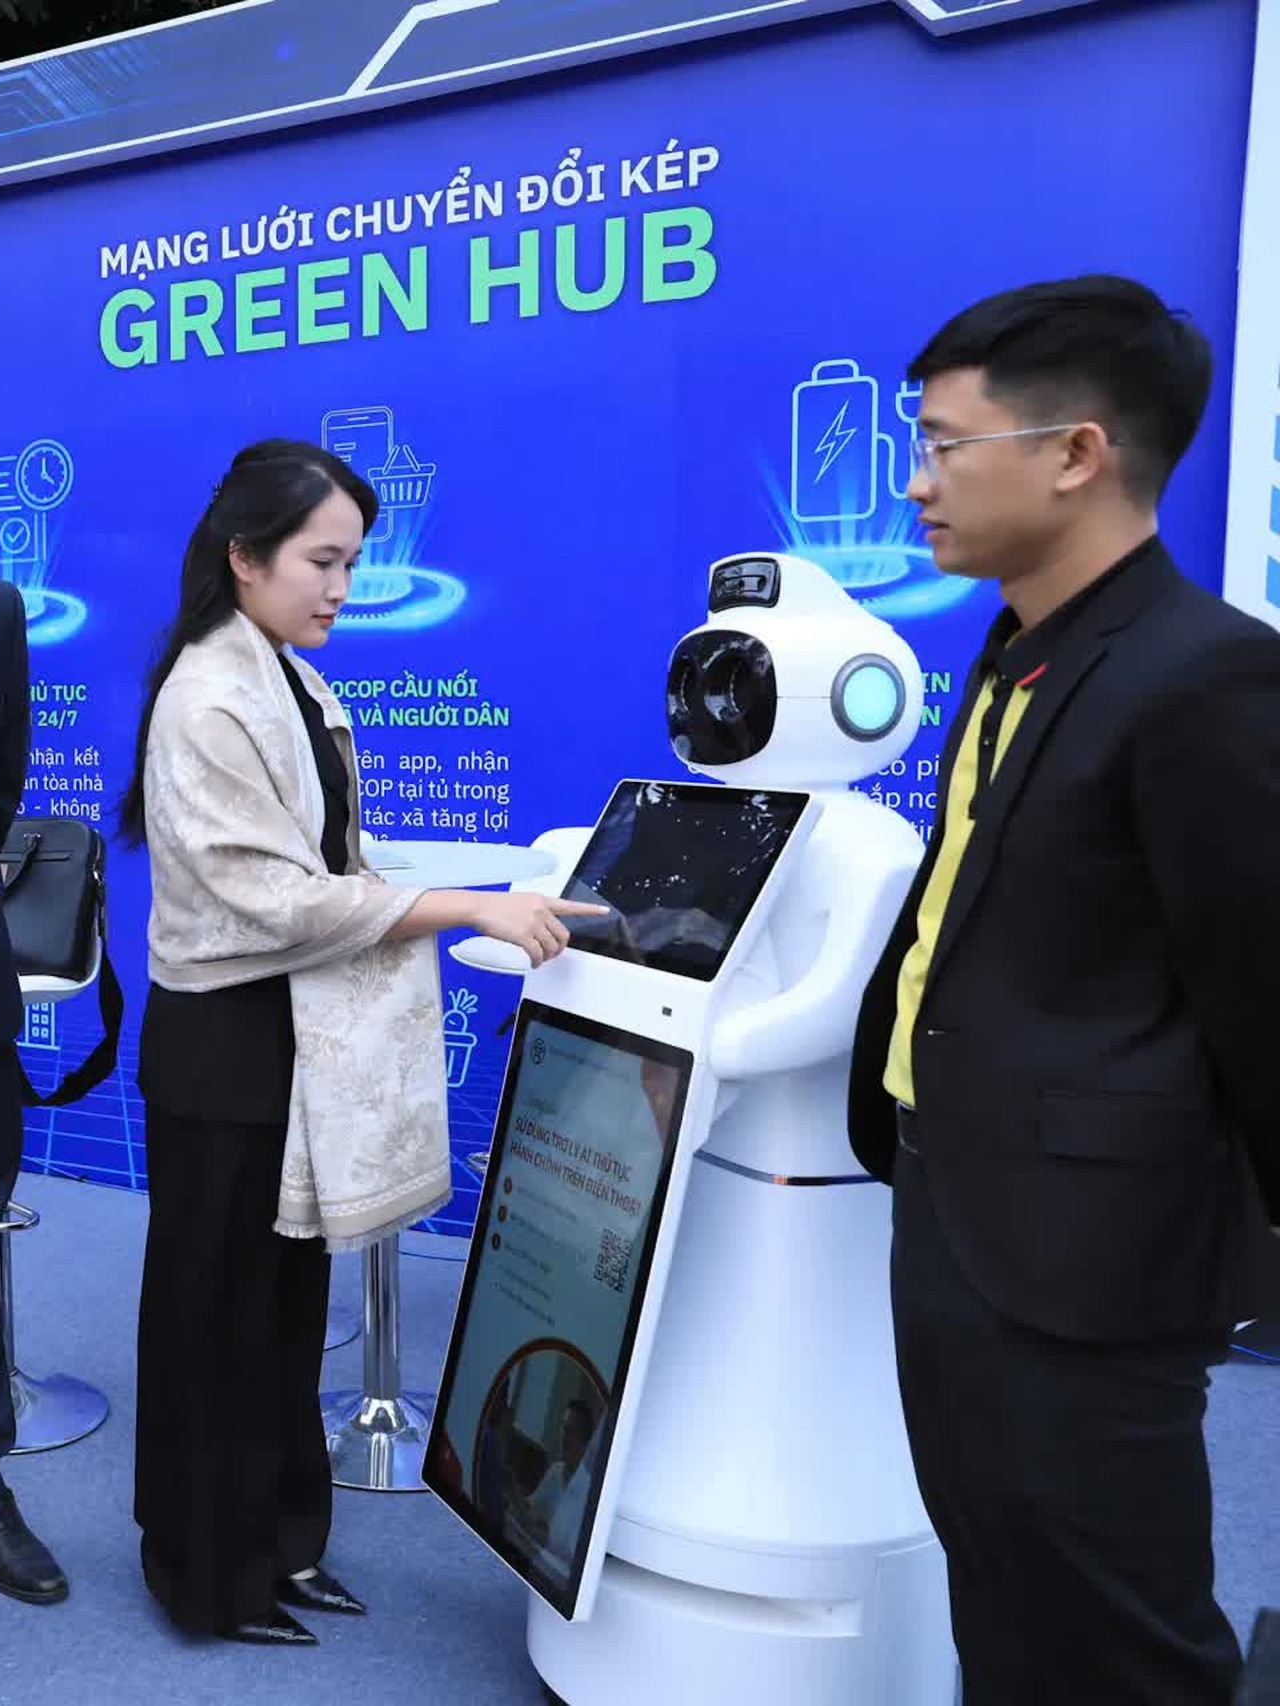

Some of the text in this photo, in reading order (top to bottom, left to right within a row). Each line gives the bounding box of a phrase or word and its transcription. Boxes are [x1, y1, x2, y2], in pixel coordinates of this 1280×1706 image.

[100, 139, 720, 280] MẠNG LƯỚI CHUYỂN ĐỔI KÉP
[98, 205, 718, 370] GREEN HUB
[52, 684, 87, 705] TỤC
[330, 668, 478, 699] OCOP CẦU NỐI
[37, 709, 78, 730] 24/7
[359, 702, 384, 726] VÀ
[390, 702, 459, 726] NGƯỜI
[464, 703, 509, 726] DÂN
[74, 745, 99, 766] kết
[356, 750, 509, 774] rên app, nhận
[73, 773, 103, 791] nhà
[398, 779, 423, 802] tại
[429, 778, 448, 798] tủ
[454, 782, 510, 804] trong
[51, 798, 101, 821] không
[364, 806, 509, 832] tác xã tăng lợi
